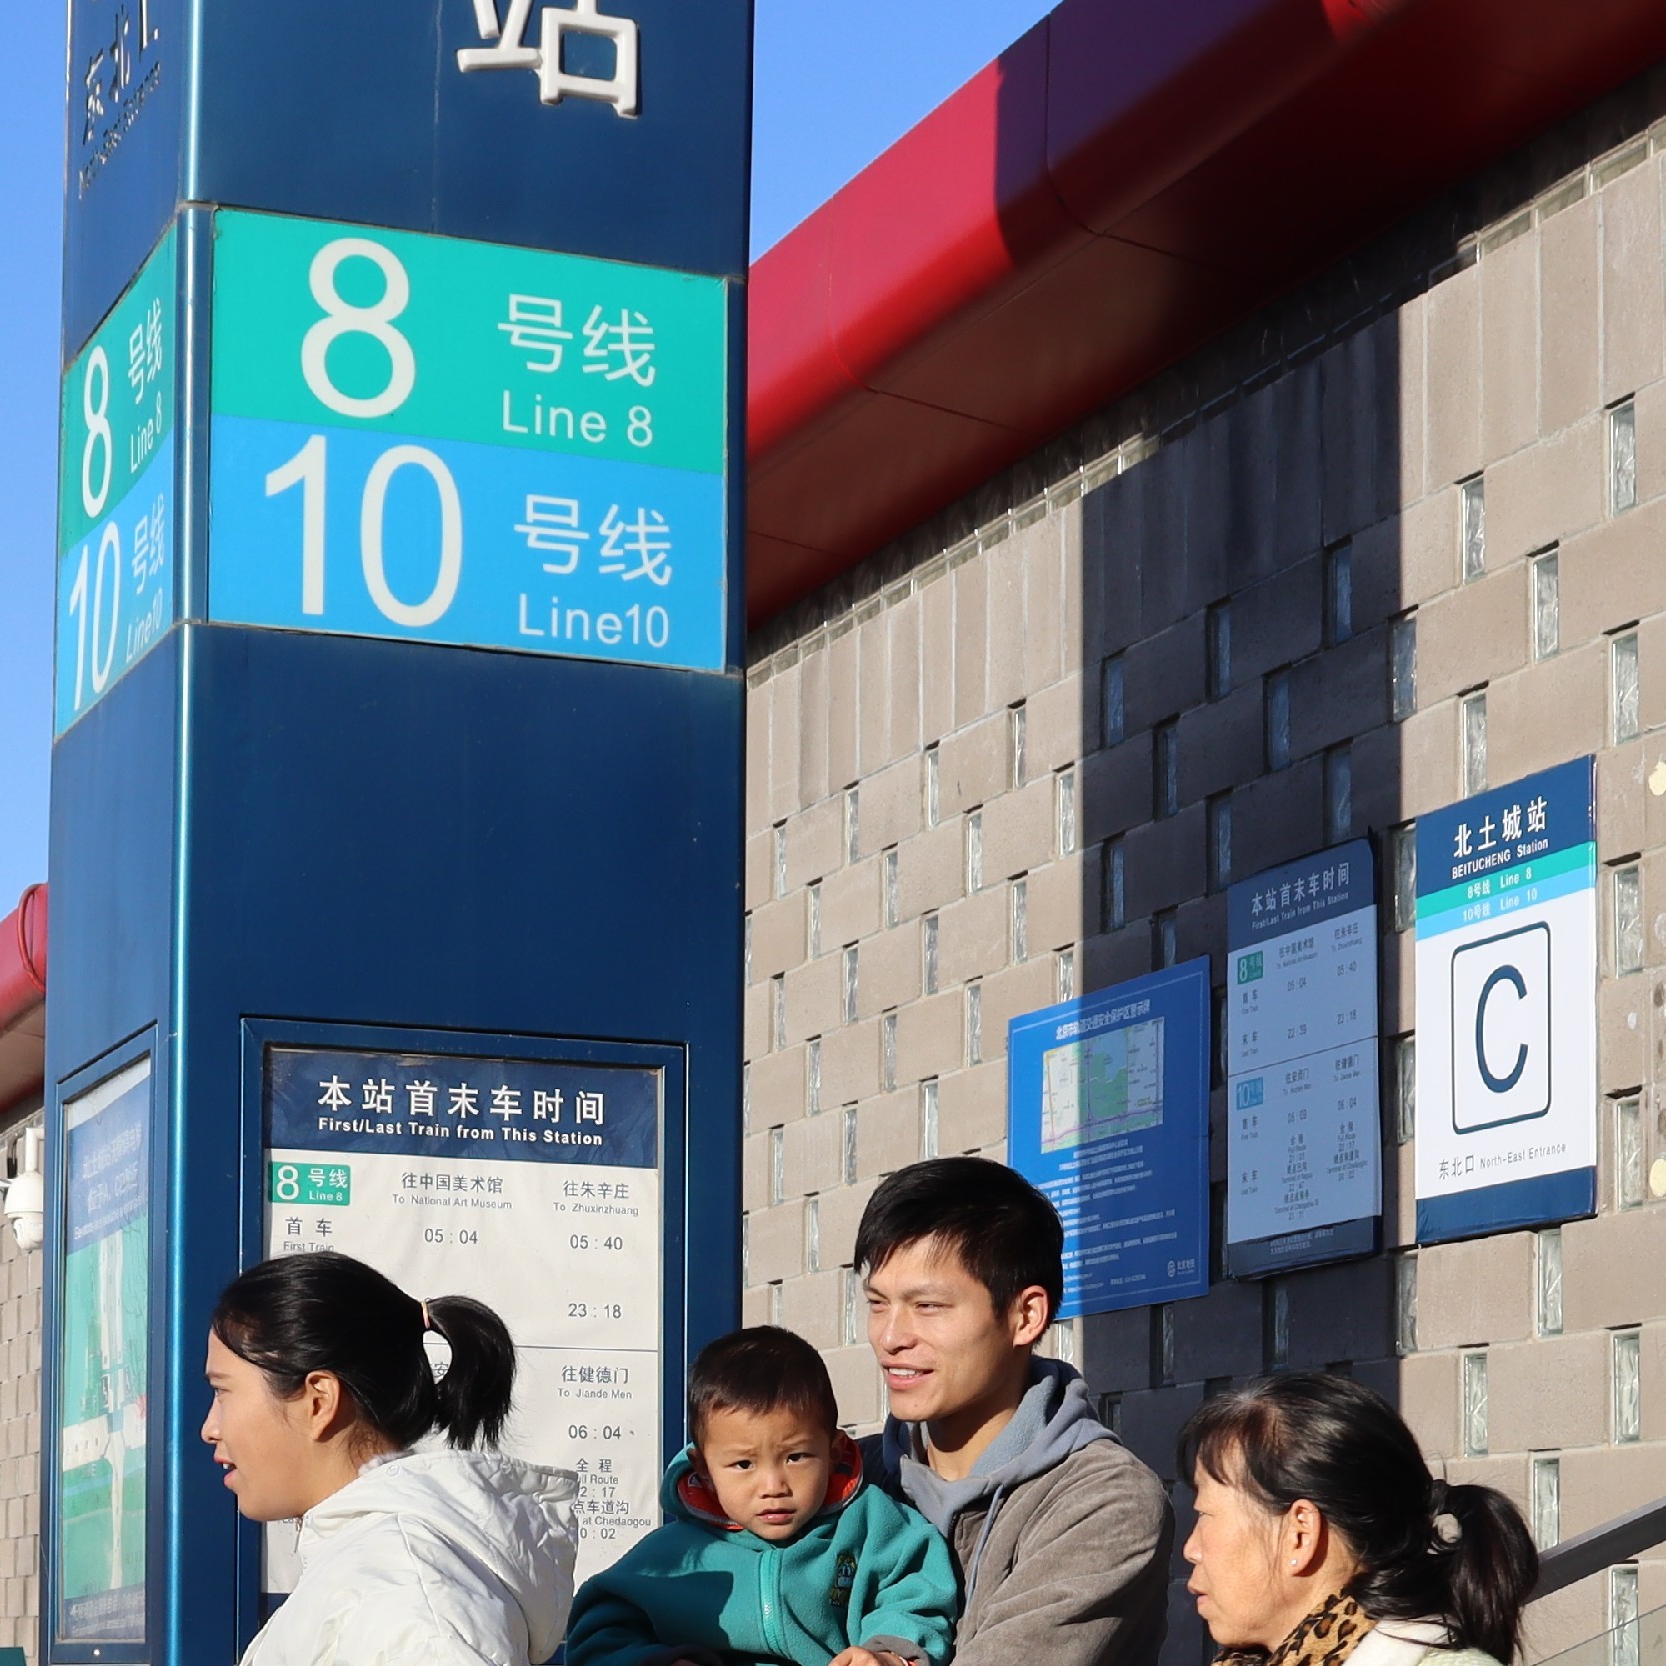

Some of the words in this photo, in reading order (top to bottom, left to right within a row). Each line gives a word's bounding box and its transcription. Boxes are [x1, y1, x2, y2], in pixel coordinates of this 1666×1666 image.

[301, 238, 416, 418] 8
[497, 294, 656, 388] 号线
[128, 298, 162, 404] 号线
[81, 345, 112, 518] 8
[131, 416, 154, 474] Line
[156, 391, 163, 434] 8
[503, 390, 606, 443] Line
[627, 405, 653, 447] 8
[132, 493, 165, 595] 号线
[265, 434, 463, 627] 10
[514, 494, 672, 586] 号线
[69, 521, 121, 710] 10
[1453, 796, 1547, 858] 北土城站
[1452, 849, 1511, 879] BEITUCHENG
[1517, 838, 1549, 858] Station
[1251, 862, 1349, 916] 本站首末车时间
[1467, 879, 1490, 899] 8号线
[1500, 872, 1519, 888] Line
[1526, 867, 1532, 880] 8
[1463, 905, 1490, 922] 10号线
[1500, 894, 1519, 910] Line
[1527, 888, 1537, 902] 10
[1239, 959, 1248, 982] 8
[1474, 964, 1528, 1094] C
[317, 1074, 605, 1125] 本站首末车时间
[318, 1117, 402, 1136] First/Last
[408, 1122, 450, 1138] Train
[457, 1124, 494, 1140] from
[502, 1127, 536, 1142] This
[543, 1129, 603, 1146] Station
[1439, 1155, 1475, 1180] 东北口
[1480, 1150, 1525, 1169] North-East
[1529, 1143, 1566, 1159] Entrance
[276, 1165, 300, 1201] 8
[308, 1168, 348, 1189] 号线
[401, 1172, 504, 1194] 往中国美术馆
[563, 1180, 629, 1200] 往朱辛庄
[309, 1190, 333, 1201] Line
[336, 1191, 343, 1202] 8
[392, 1194, 405, 1204] To
[411, 1195, 451, 1206] National
[453, 1196, 469, 1207] Art
[471, 1197, 512, 1209] Museum
[553, 1202, 566, 1212] To
[572, 1202, 639, 1217] Zhuxinzhuang
[286, 1217, 333, 1236] 首车
[561, 1366, 629, 1385] 往健德门
[558, 1388, 570, 1397] To
[576, 1388, 608, 1399] Jiande
[611, 1389, 632, 1399] Men
[576, 1458, 612, 1473] 全程
[590, 1474, 618, 1485] Route
[574, 1500, 629, 1515] 点车道沟
[580, 1487, 615, 1498] 2:17
[580, 1528, 615, 1540] 0:02
[583, 1517, 592, 1525] at
